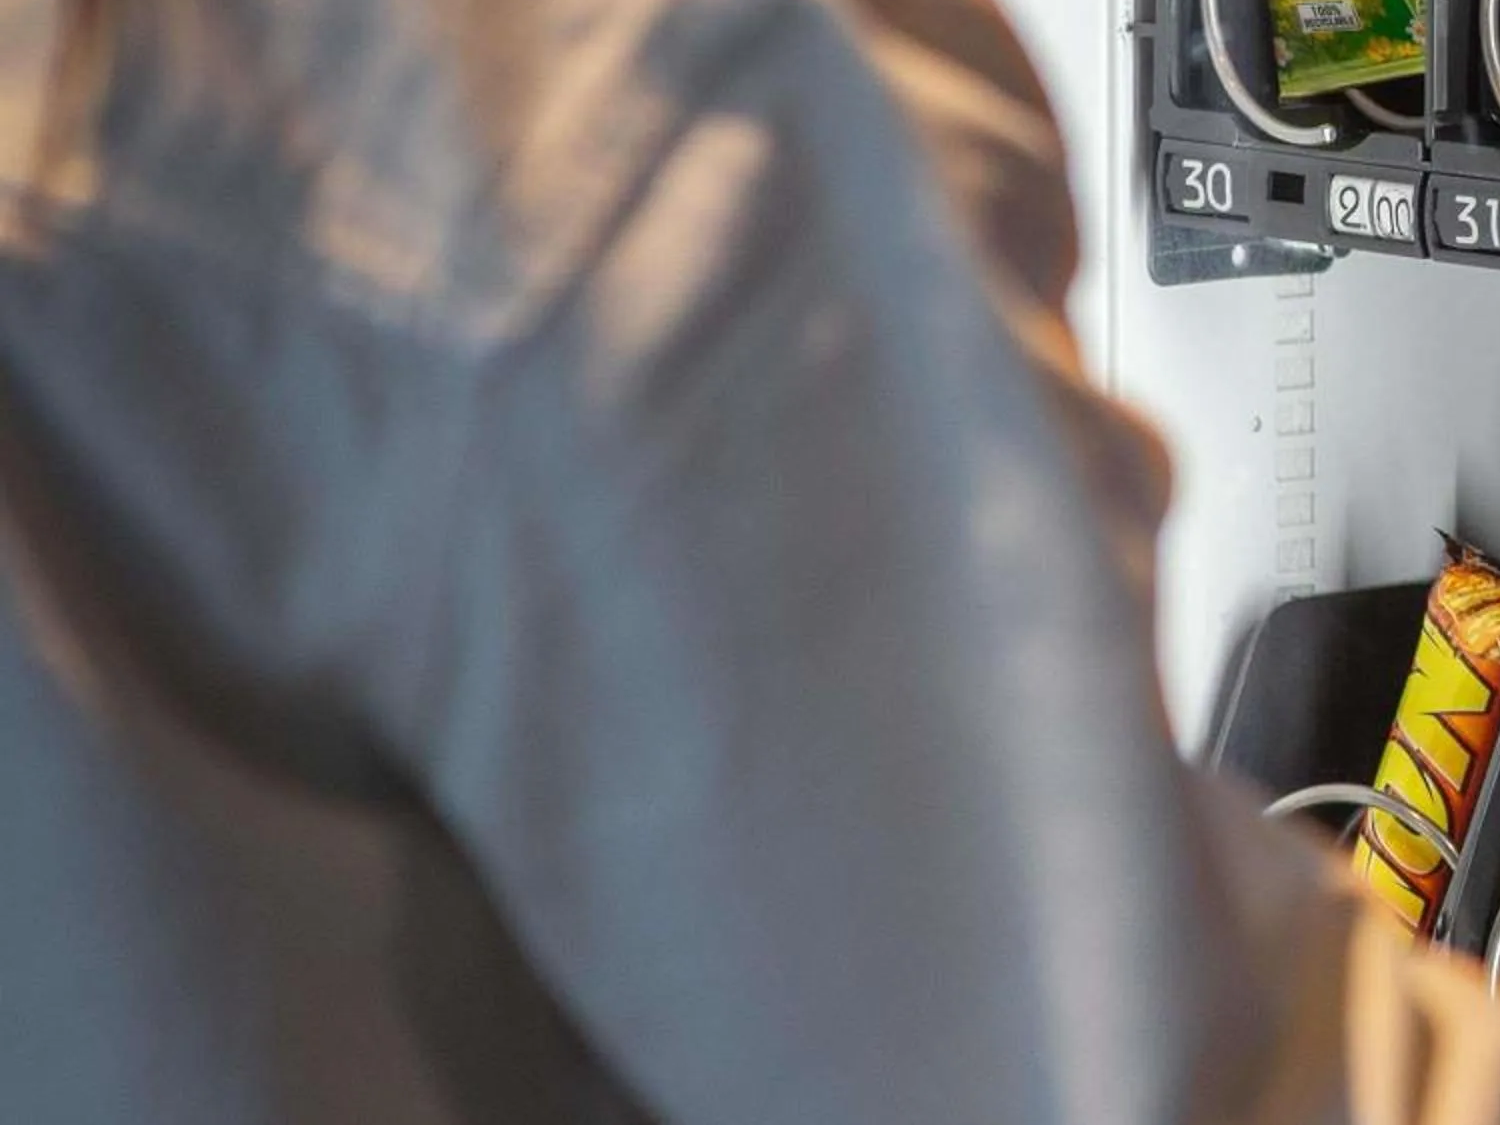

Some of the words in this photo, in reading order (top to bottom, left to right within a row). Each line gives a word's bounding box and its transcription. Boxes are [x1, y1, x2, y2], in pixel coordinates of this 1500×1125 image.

[1181, 158, 1233, 212] 30
[1454, 194, 1500, 248] 31
[1352, 613, 1493, 937] ION
